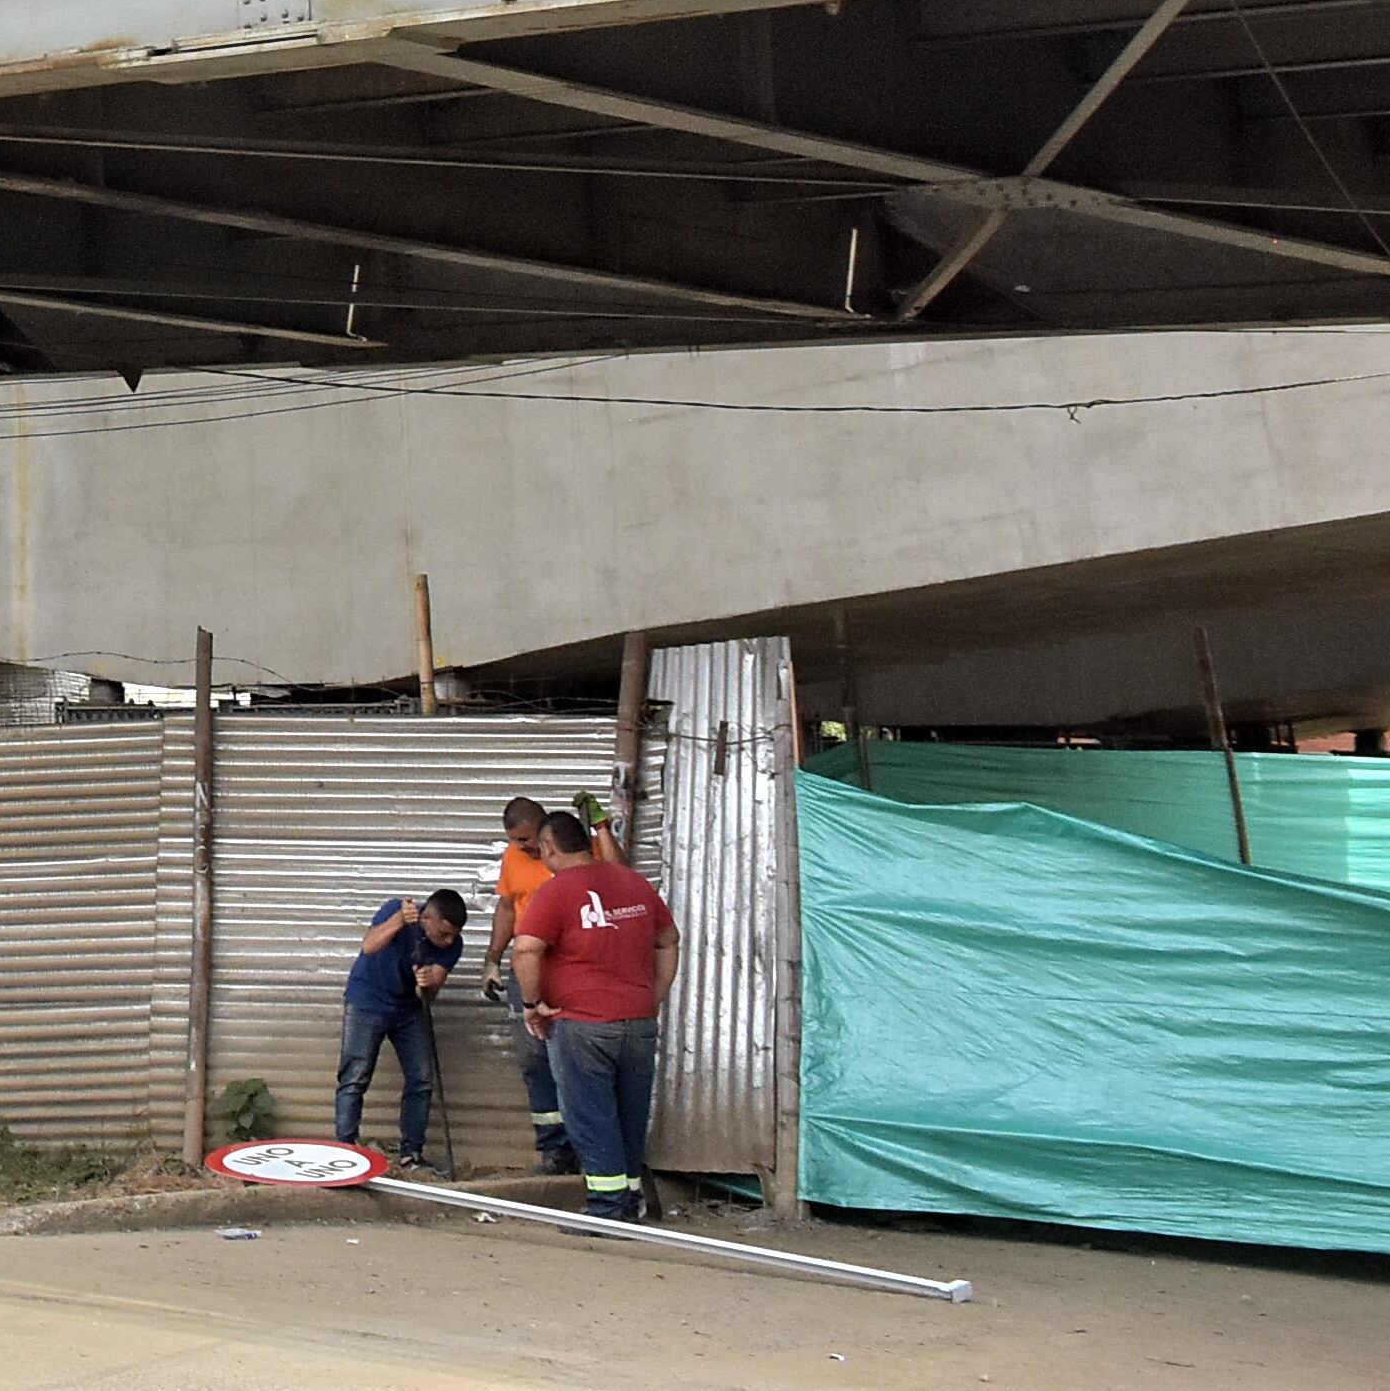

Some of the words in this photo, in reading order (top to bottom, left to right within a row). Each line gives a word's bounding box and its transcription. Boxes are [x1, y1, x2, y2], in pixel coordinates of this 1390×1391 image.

[232, 1147, 295, 1166] UNO
[283, 1159, 315, 1169] A
[295, 1159, 358, 1179] UNO
